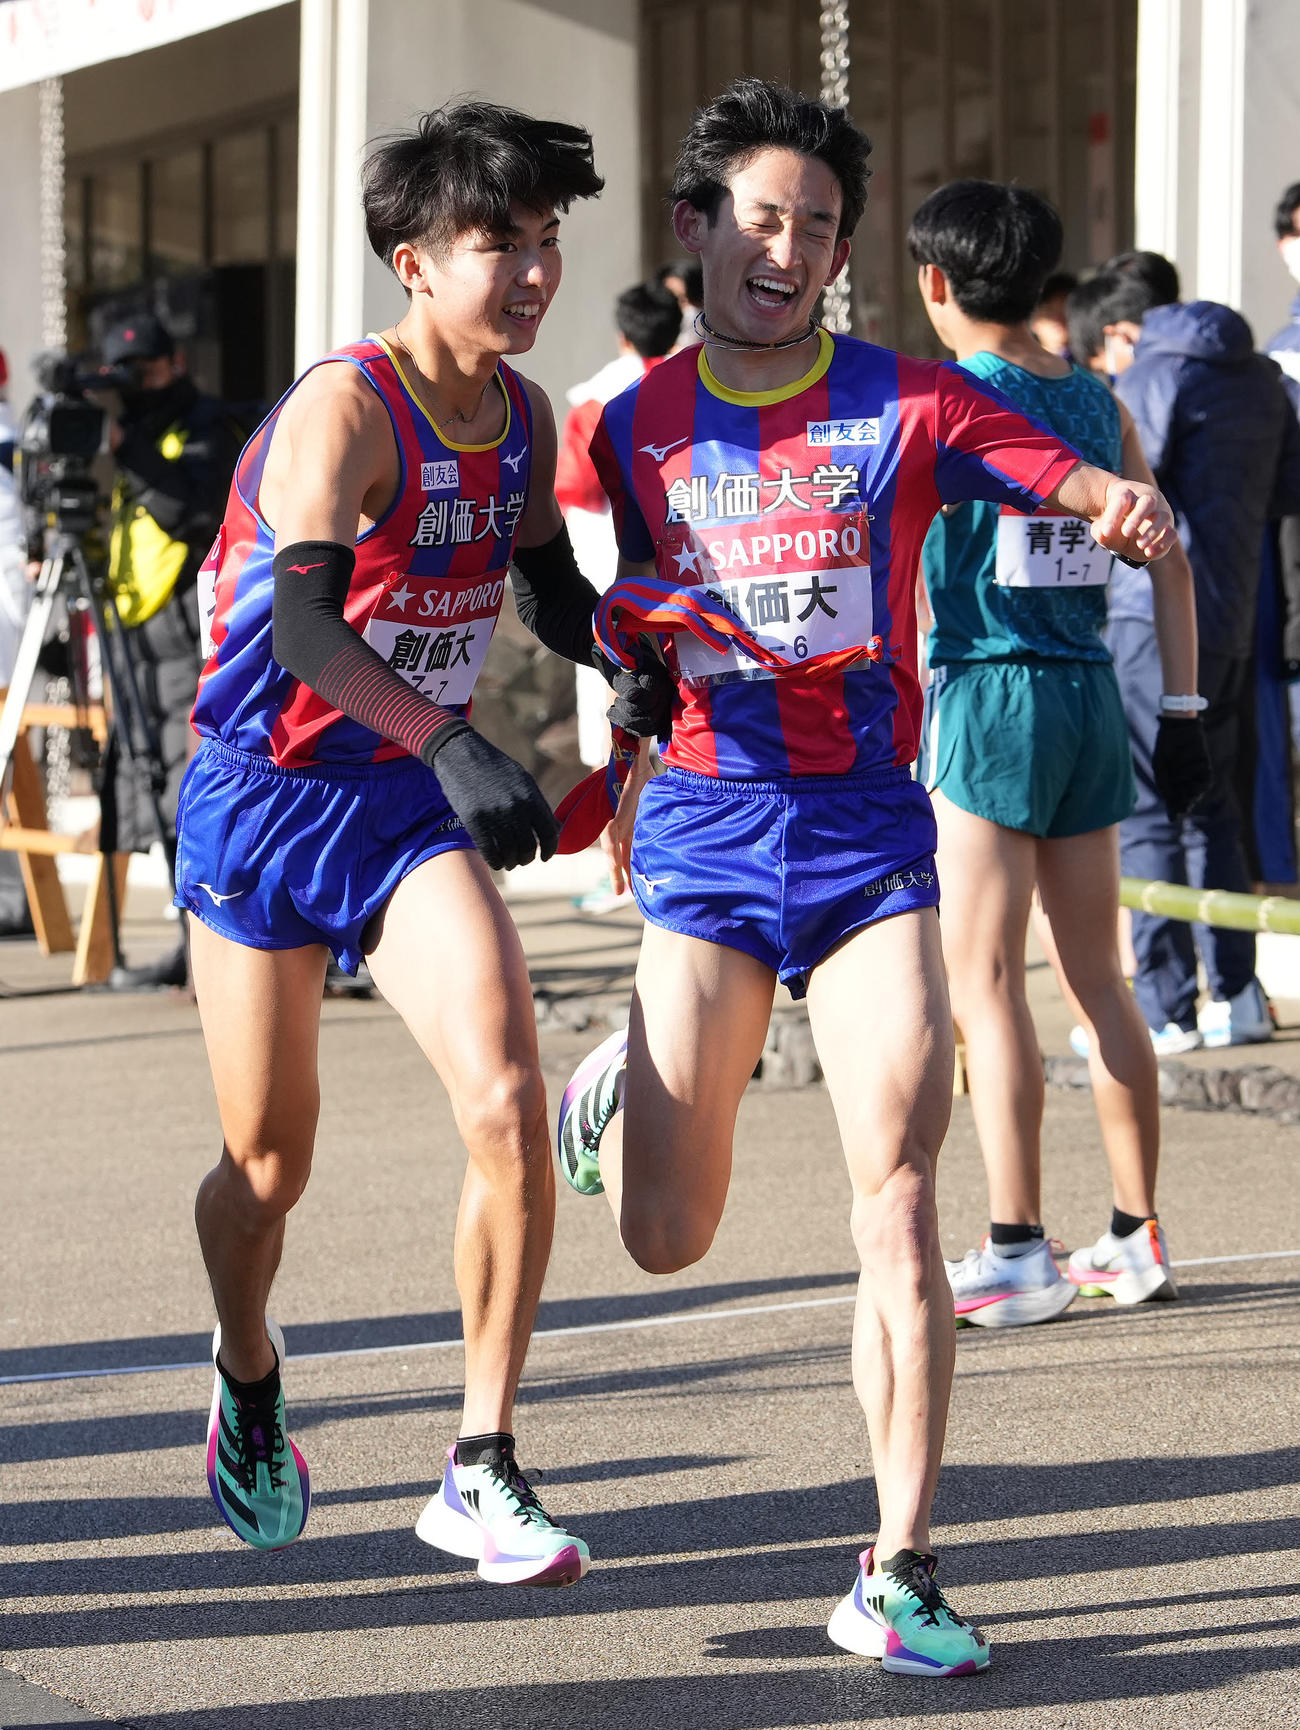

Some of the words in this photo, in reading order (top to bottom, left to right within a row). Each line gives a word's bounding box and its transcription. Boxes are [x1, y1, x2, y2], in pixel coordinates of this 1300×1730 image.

[809, 421, 877, 443] 創友会
[421, 464, 458, 487] 創友会
[665, 464, 859, 523] 創価大学
[410, 491, 526, 547] 創価大学
[708, 526, 862, 571] SAPPORO
[1055, 557, 1091, 581] 1-7
[417, 580, 504, 617] SAPPORO
[863, 871, 935, 897] 創価大学
